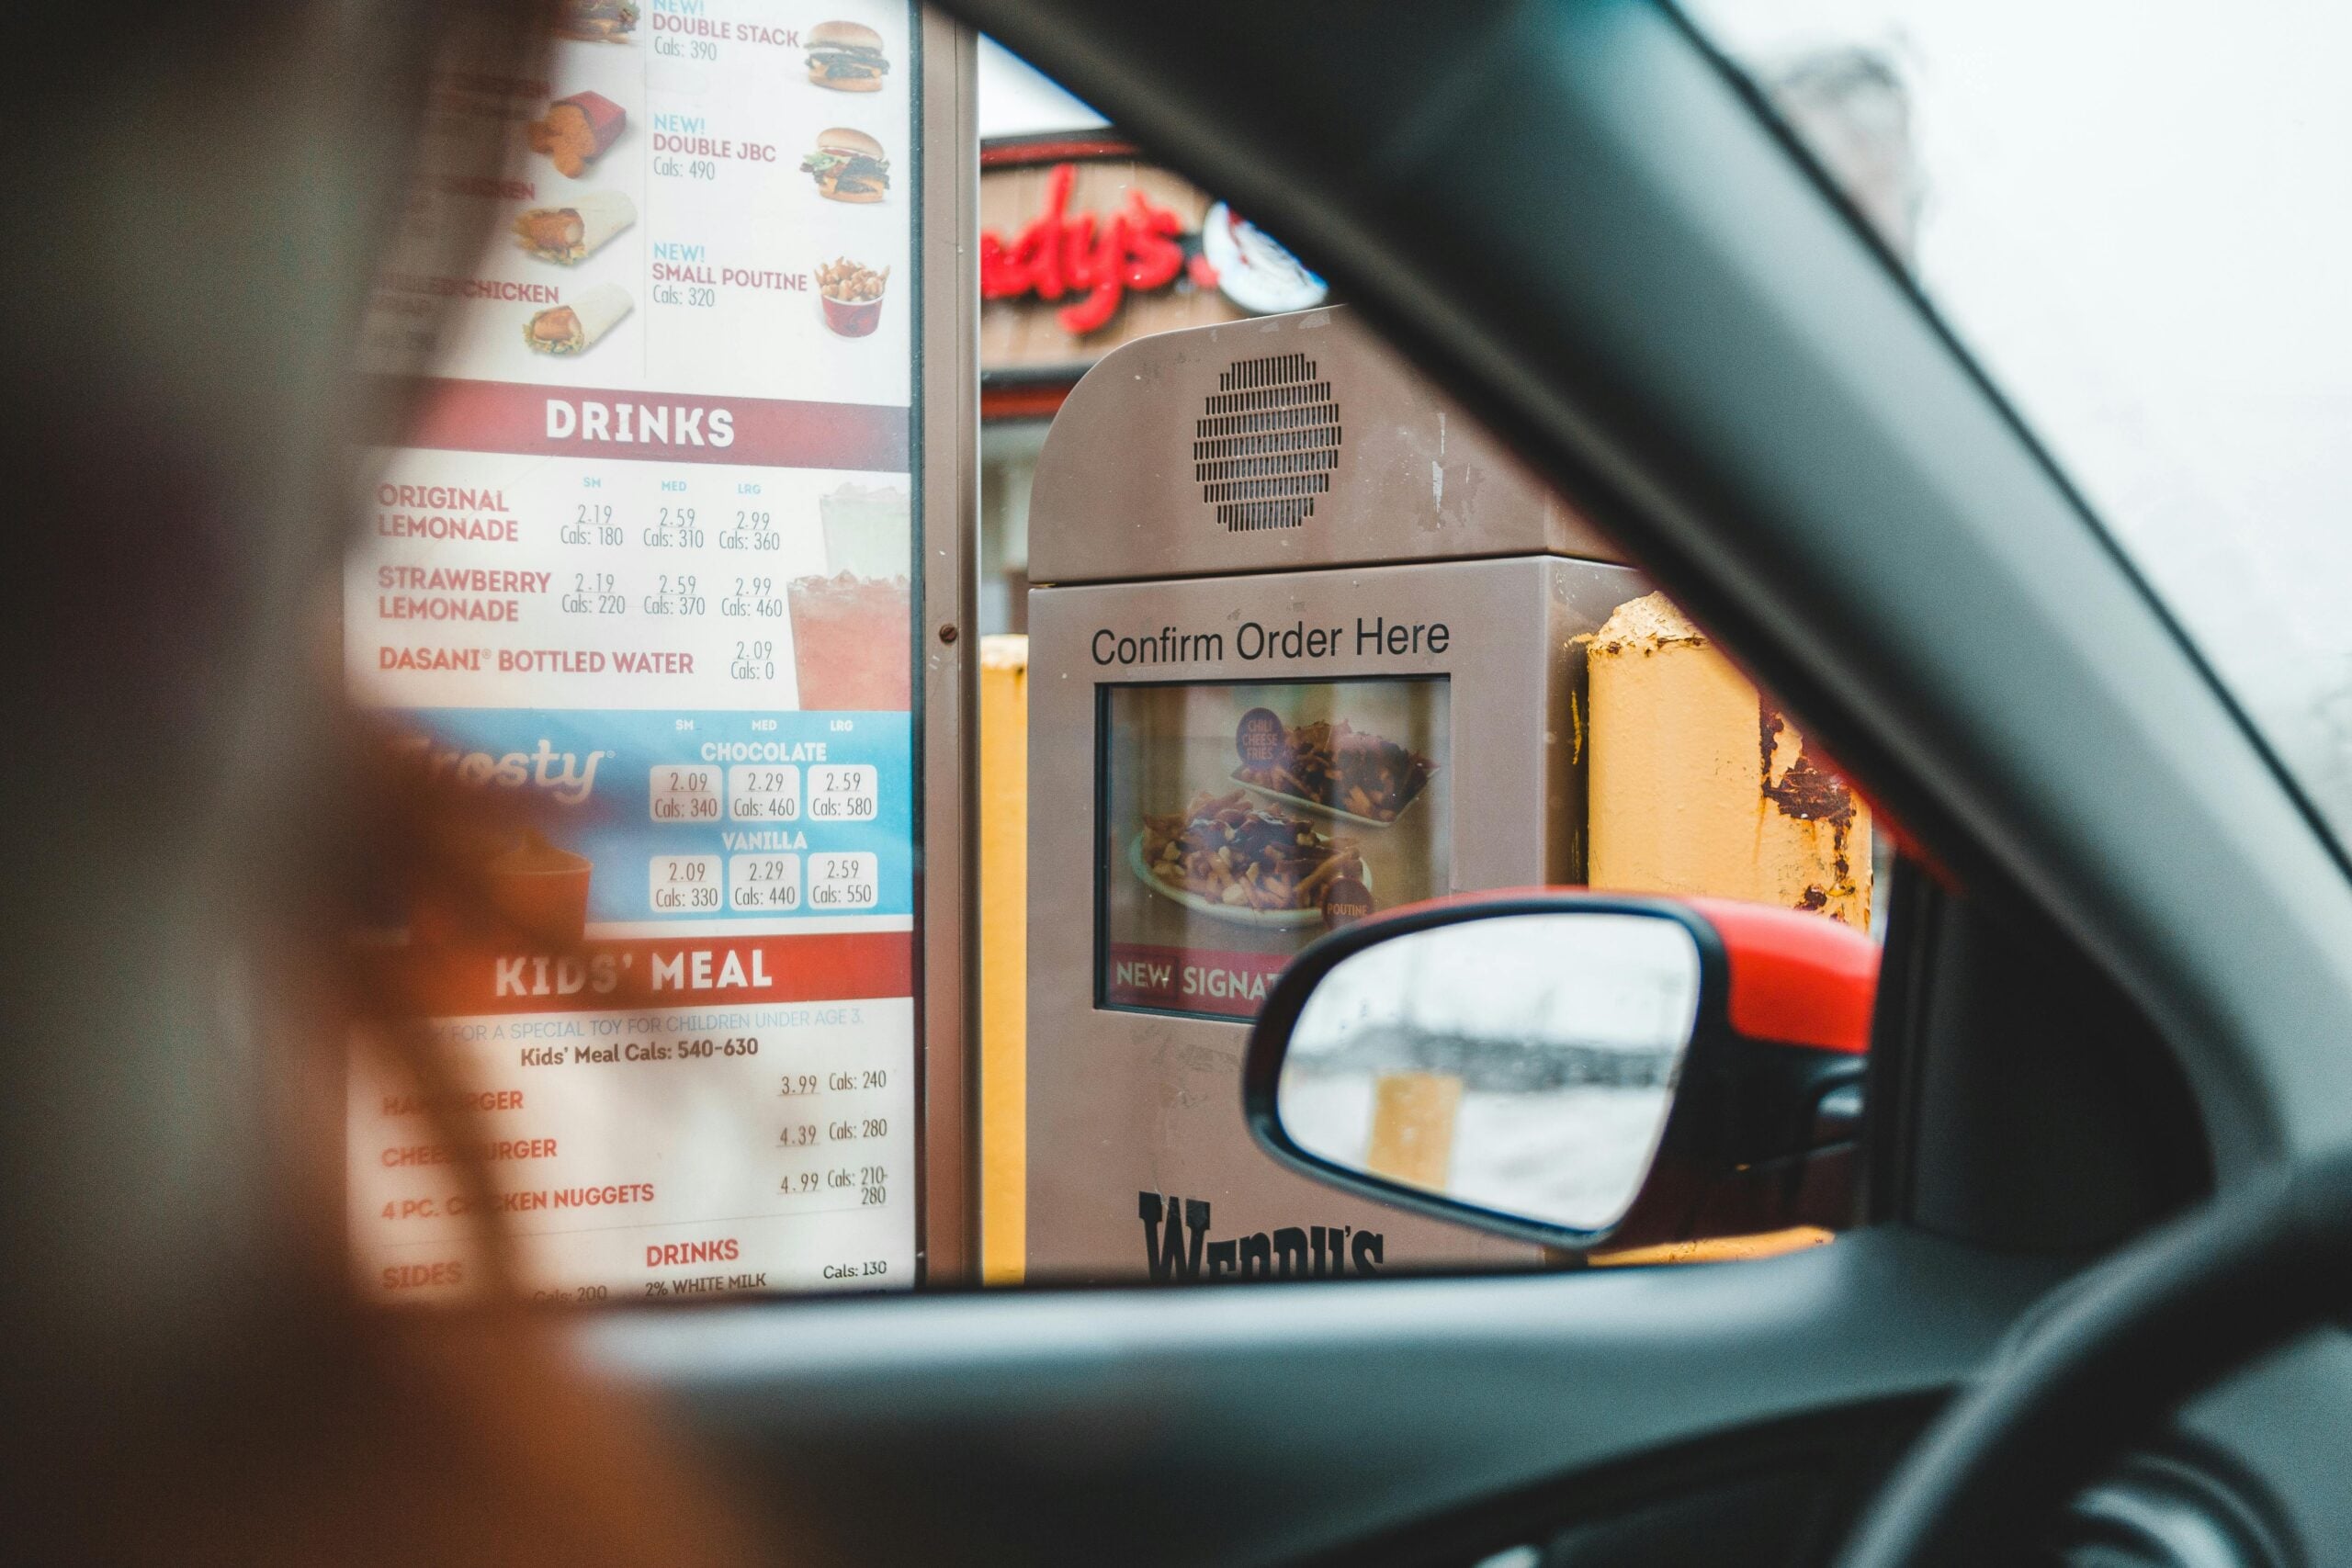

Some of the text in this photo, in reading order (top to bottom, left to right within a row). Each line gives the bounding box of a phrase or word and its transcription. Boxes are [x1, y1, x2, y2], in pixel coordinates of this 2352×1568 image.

[653, 0, 705, 16] NEW!
[652, 13, 799, 48] DOUBLE STACK
[654, 36, 718, 61] Cals: 390
[653, 113, 705, 135] NEW!
[653, 132, 776, 163] DOUBLE JBC
[653, 156, 716, 181] Cals: 490
[653, 242, 705, 263] NEW!
[652, 263, 808, 292] SMALL POUTINE
[653, 284, 715, 308] Cals: 320
[546, 399, 735, 447] DRINKS
[583, 477, 602, 488] SM
[661, 480, 687, 491] MED
[737, 483, 762, 495] LRG
[377, 483, 509, 513] ORIGINAL
[577, 503, 612, 524] 2.19
[660, 507, 695, 527] 2.59
[736, 511, 770, 531] 2.99
[378, 513, 518, 542] LEMONADE
[560, 525, 624, 547] Cals: 180
[643, 527, 705, 549] Cals: 310
[718, 530, 780, 551] Cals: 360
[378, 566, 552, 593] STRAWBERRY
[575, 573, 614, 592] 2.19
[660, 575, 696, 595] 2.59
[735, 577, 772, 596] 2.99
[379, 595, 519, 622] LEMONADE
[562, 593, 626, 615] Cals: 220
[644, 595, 706, 615] Cals: 370
[721, 597, 783, 617] Cals: 460
[736, 641, 773, 660] 2.09
[1091, 617, 1450, 665] Confirm Order Here
[498, 649, 605, 672] BOTTLED
[612, 651, 695, 674] WATER
[730, 660, 775, 681] Cals: 0
[675, 719, 694, 731] SM
[752, 719, 777, 731] MED
[830, 719, 854, 732] LRG
[1243, 734, 1277, 747] CHEESE
[701, 741, 827, 762] CHOCOLATE
[1247, 746, 1273, 761] FRIES
[670, 772, 707, 791] 2.09
[748, 772, 784, 791] 2.29
[826, 772, 861, 791] 2.59
[654, 798, 718, 818] Cals: 340
[734, 797, 795, 817] Cals: 460
[813, 797, 872, 817] Cals: 580
[722, 830, 808, 851] VANILLA
[669, 863, 706, 882] 2.09
[749, 861, 784, 881] 2.29
[827, 860, 859, 879] 2.59
[655, 887, 718, 908] Cals: 330
[735, 886, 796, 906] Cals: 440
[812, 884, 872, 904] Cals: 550
[1327, 903, 1367, 917] POUTINE
[651, 949, 773, 990] MEAL
[1116, 962, 1170, 989] NEW
[492, 1024, 504, 1040] A
[511, 1021, 584, 1039] SPECIAL
[590, 1020, 623, 1036] TOY
[628, 1018, 661, 1034] FOR
[666, 1013, 751, 1032] CHILDREN
[756, 1010, 808, 1029] UNDER
[816, 1009, 846, 1026] AGE
[574, 1043, 620, 1065] Meal
[625, 1042, 672, 1062] Cals:
[678, 1037, 759, 1058] 540-630
[781, 1076, 817, 1095] 3.99
[829, 1070, 887, 1090] Cals: 240
[780, 1125, 816, 1145] 4.39
[829, 1119, 887, 1140] Cals: 280
[781, 1172, 819, 1194] 4.99
[828, 1168, 855, 1188] Cals:
[381, 1201, 396, 1220] 4
[402, 1199, 441, 1219] PC.
[554, 1183, 654, 1208] NUGGETS
[862, 1186, 887, 1205] 280
[646, 1239, 740, 1267] DRINKS
[382, 1261, 462, 1290] SIDES
[823, 1261, 887, 1280] Cals: 130
[645, 1273, 766, 1297] 2% WHITE MILK
